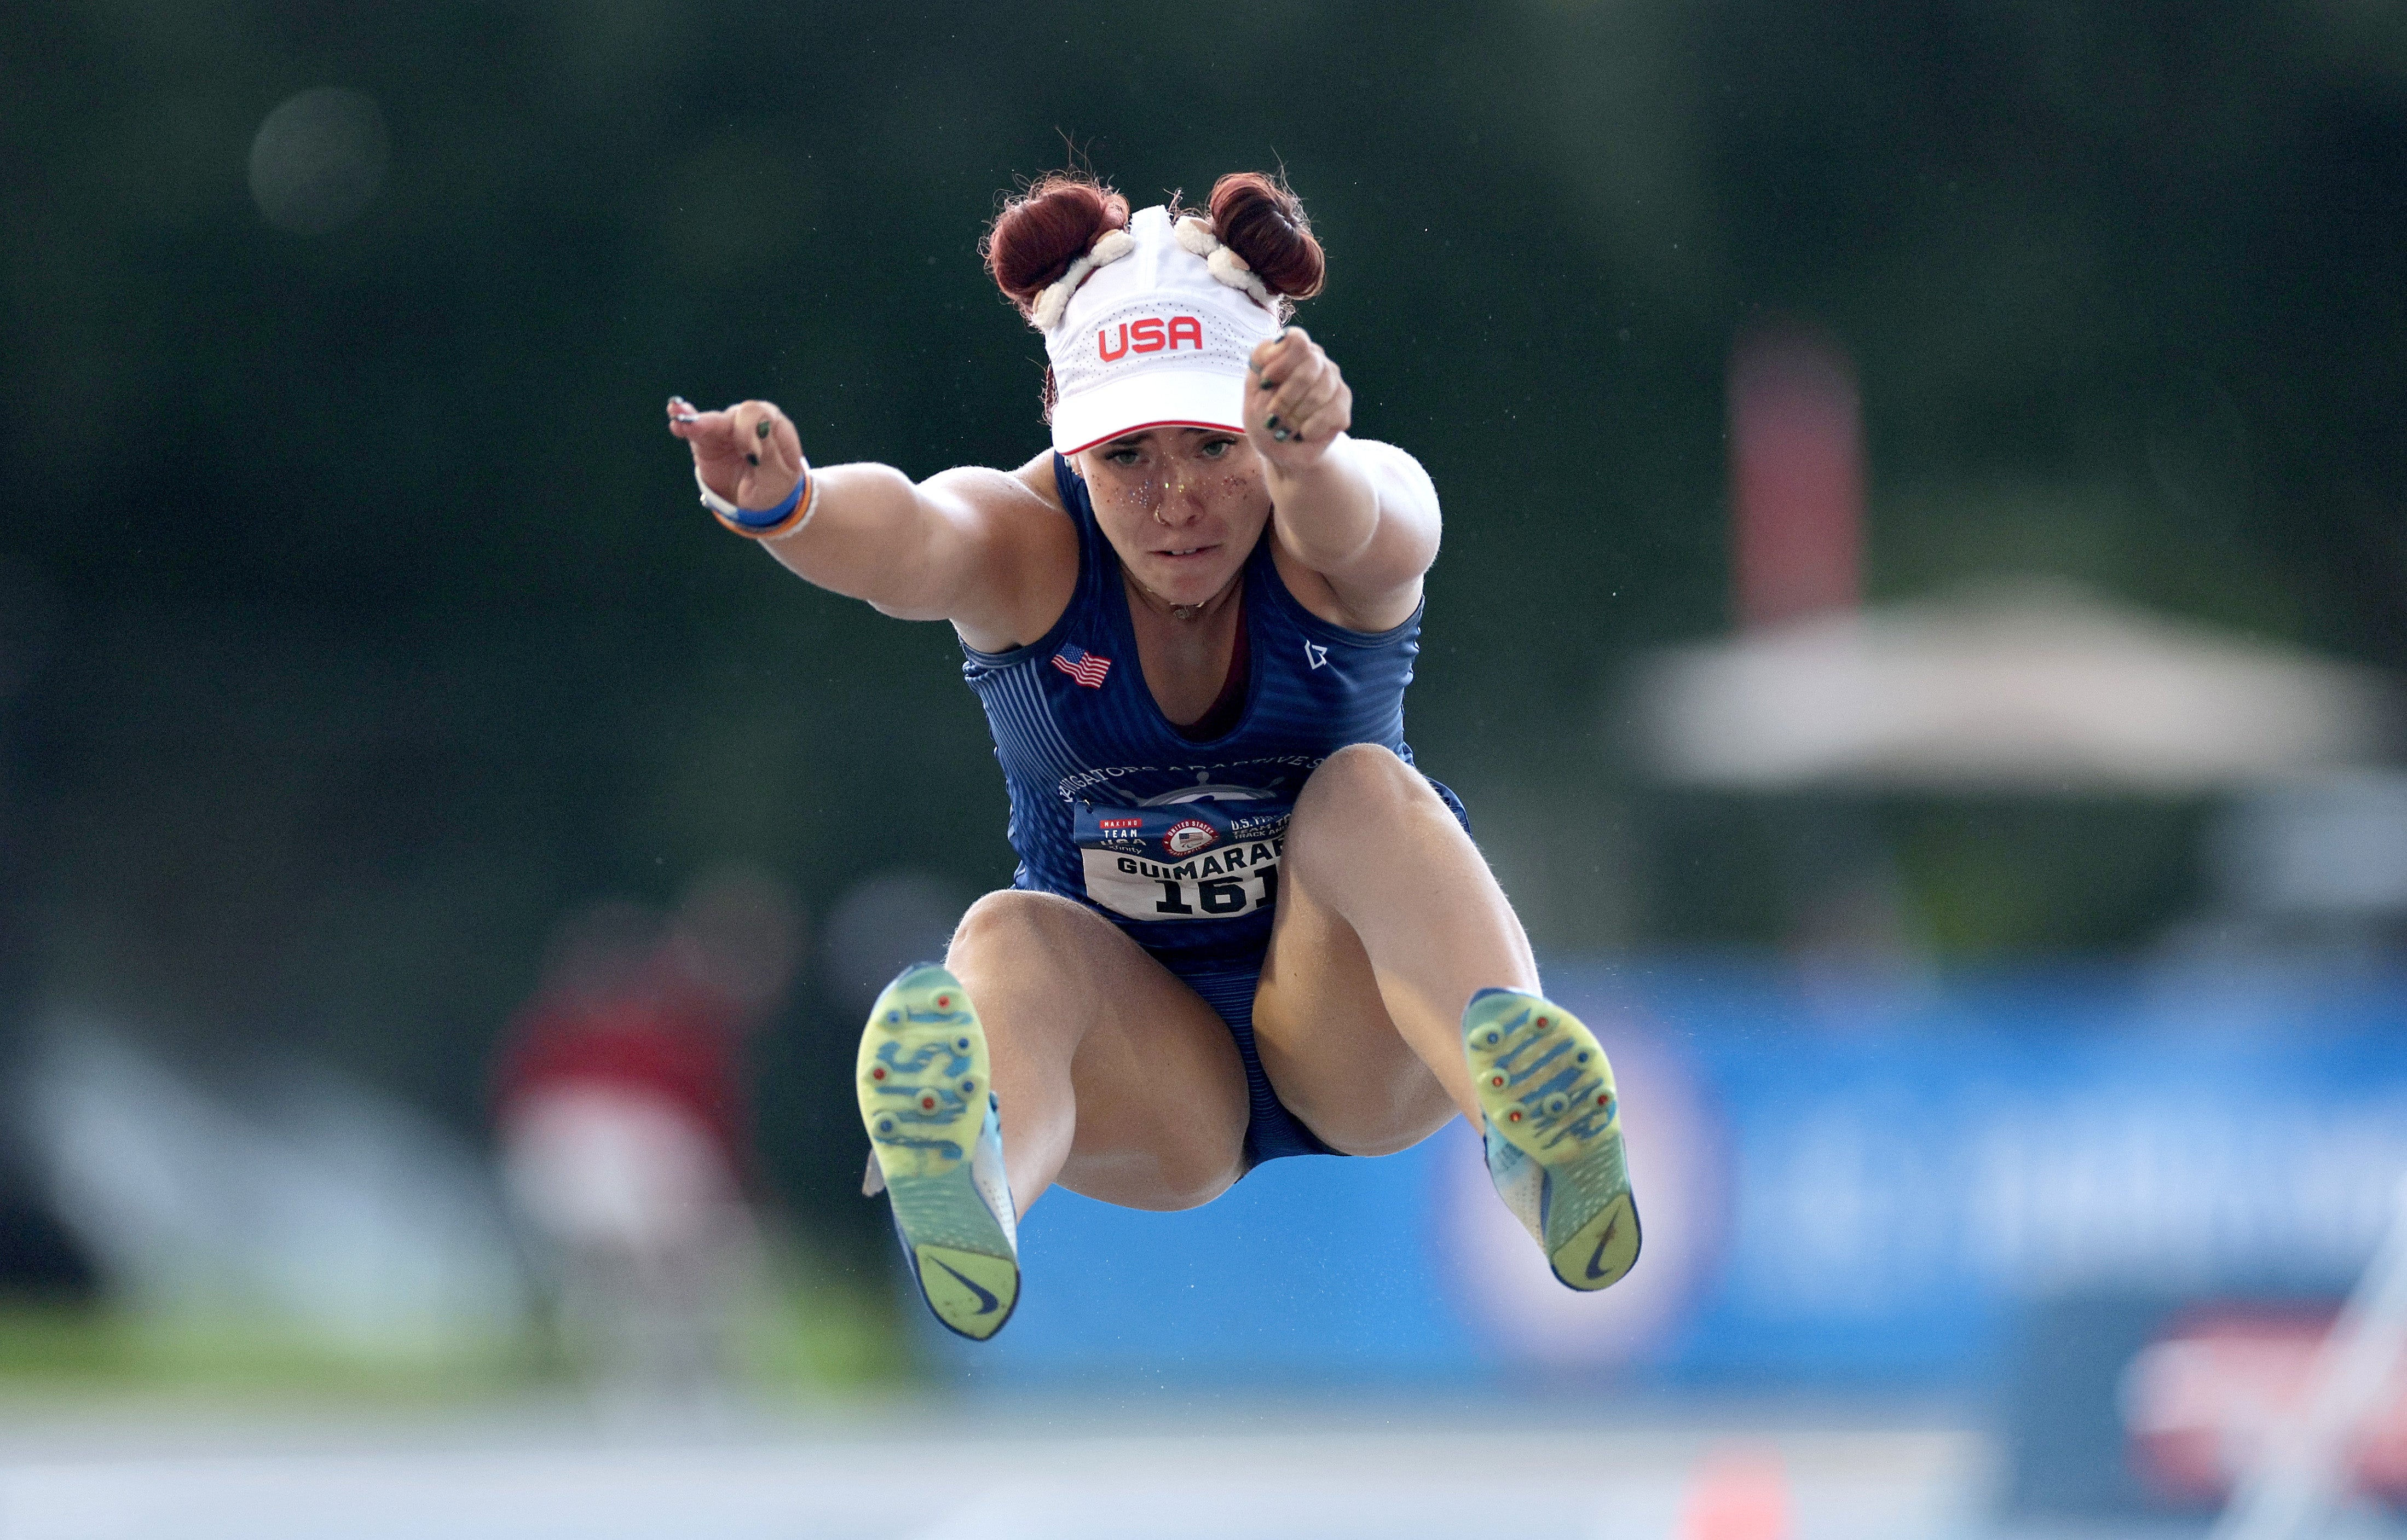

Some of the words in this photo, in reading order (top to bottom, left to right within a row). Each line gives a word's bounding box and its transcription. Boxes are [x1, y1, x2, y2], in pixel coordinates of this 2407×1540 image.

[1099, 316, 1202, 362] USA
[1168, 821, 1189, 836] UNITED
[1192, 821, 1214, 834] STATES
[1231, 818, 1253, 830] U.S.
[1104, 829, 1137, 838] TEAM
